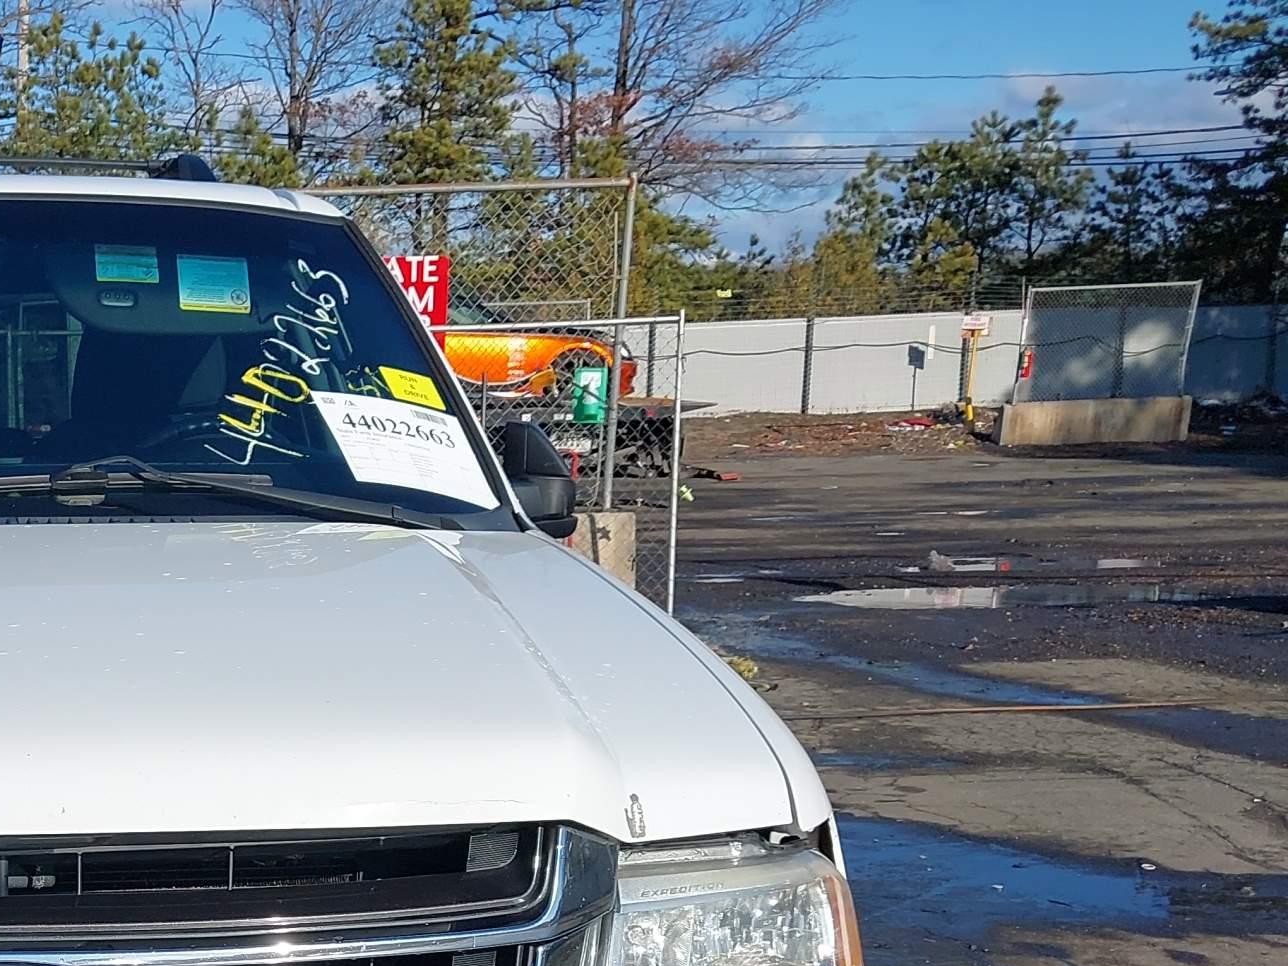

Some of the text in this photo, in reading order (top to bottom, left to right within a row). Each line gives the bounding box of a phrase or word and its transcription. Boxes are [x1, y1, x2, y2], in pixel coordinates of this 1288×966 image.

[403, 389, 429, 400] DRIVE
[342, 412, 456, 449] 44022663
[640, 882, 724, 898] EXPEDITION
